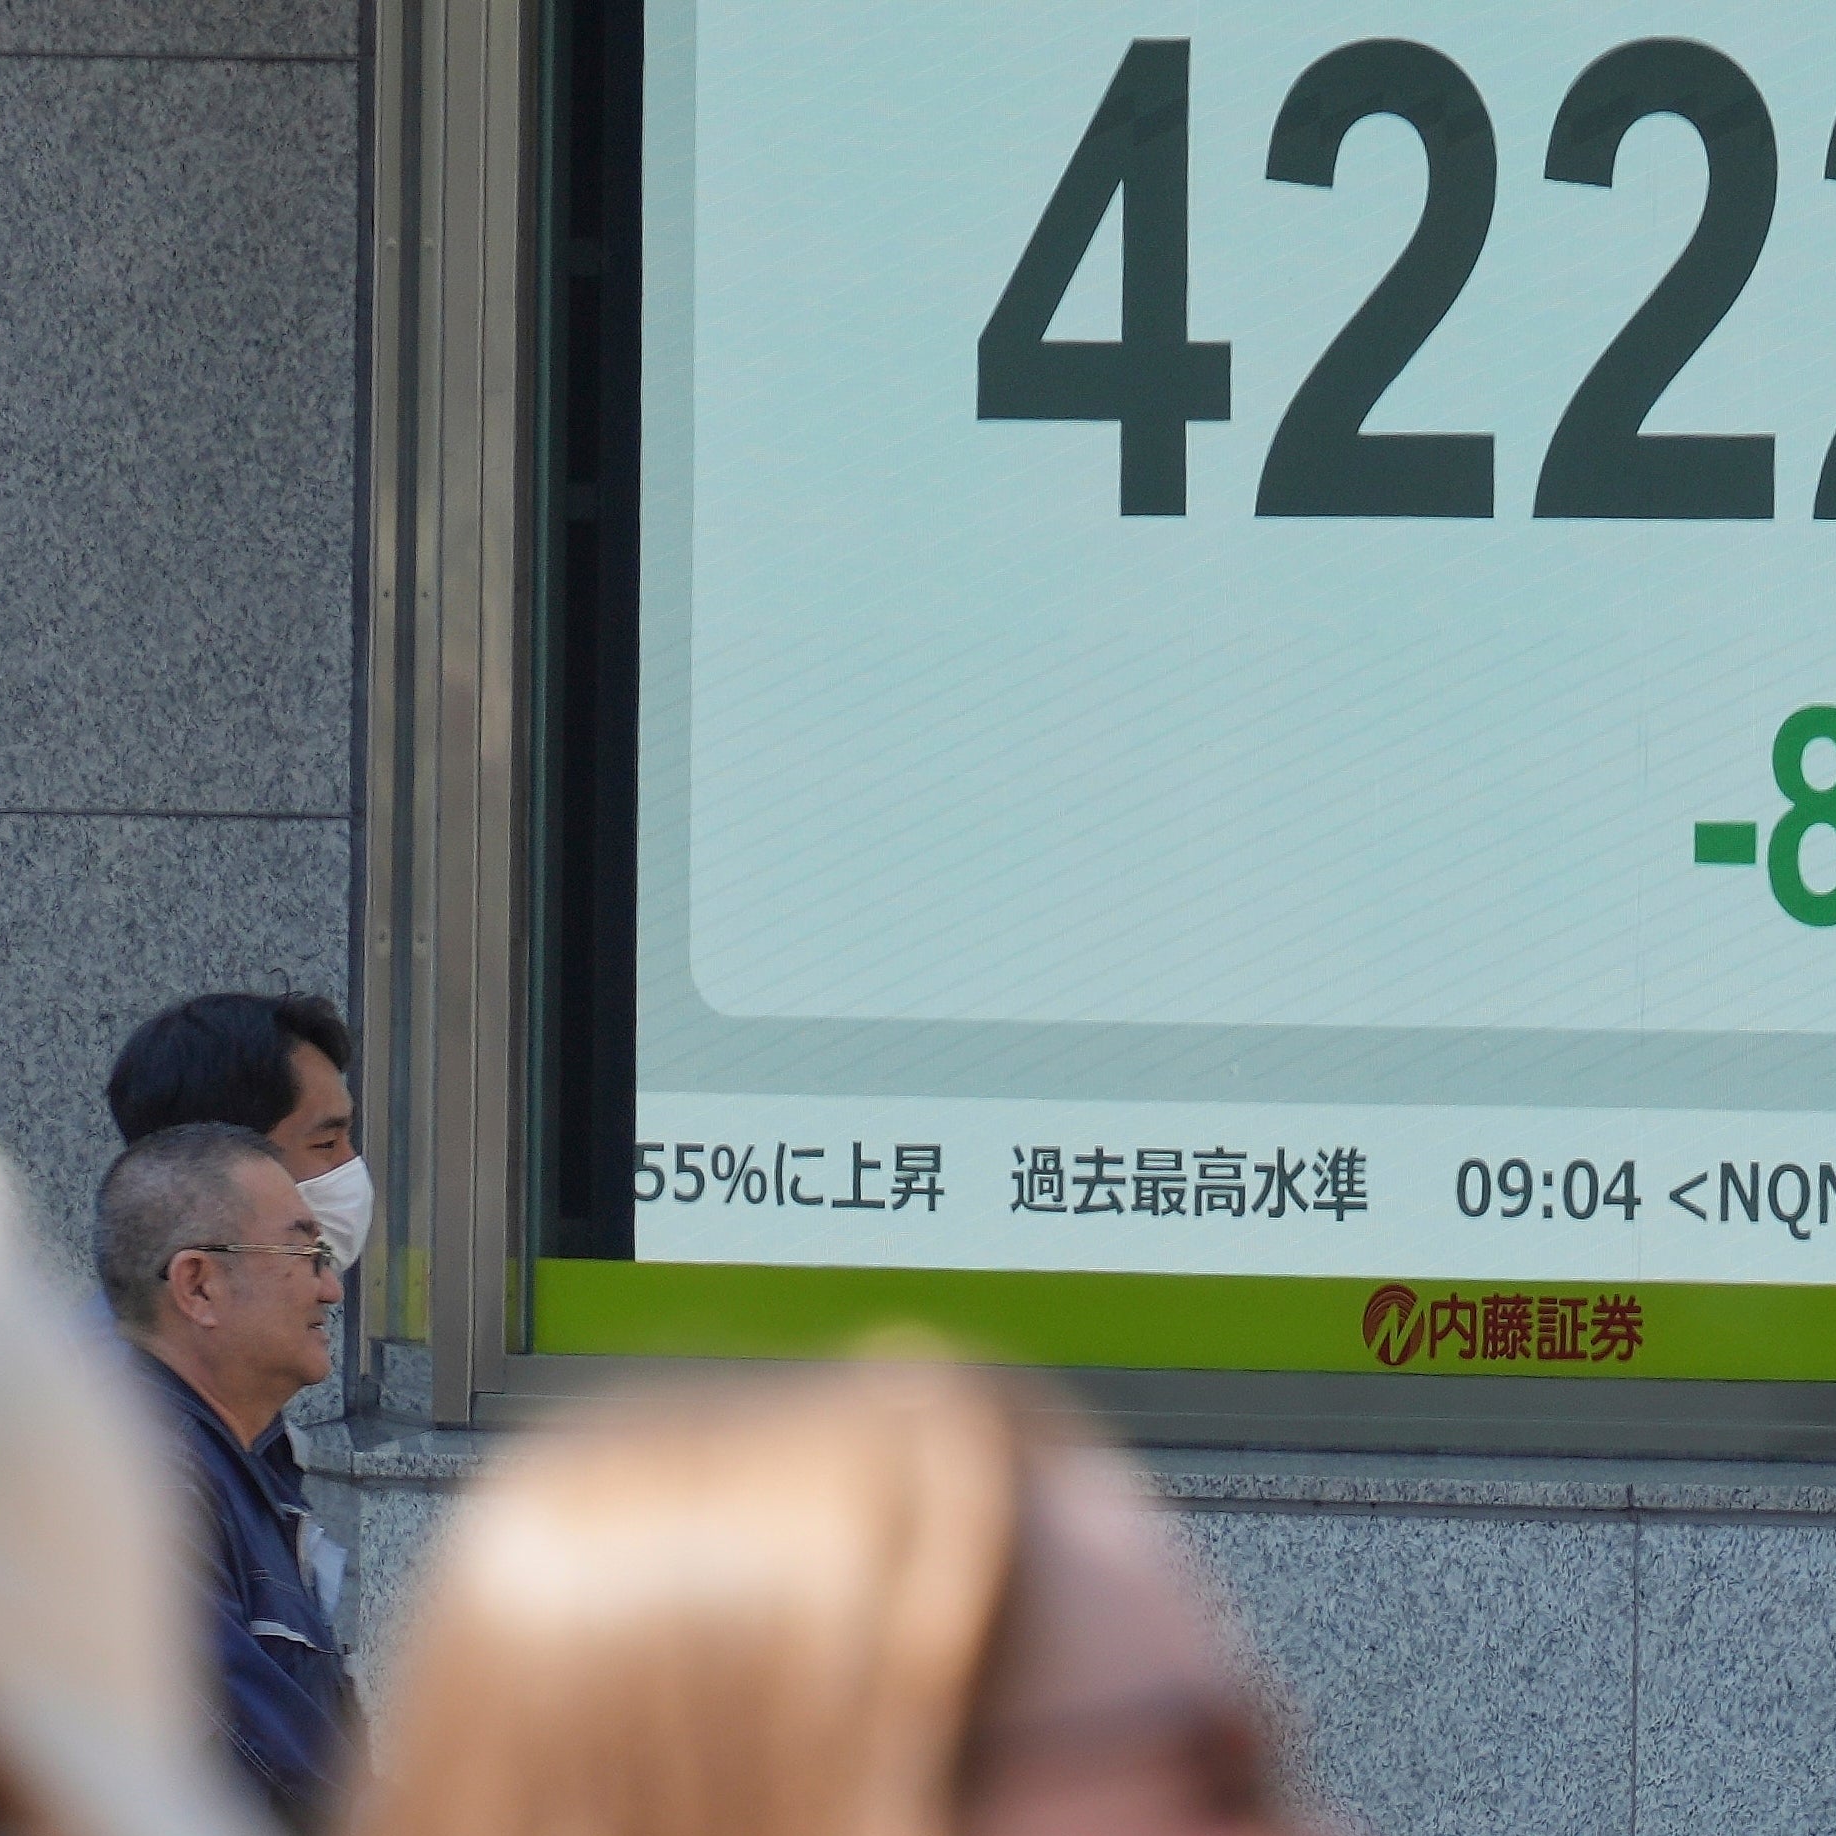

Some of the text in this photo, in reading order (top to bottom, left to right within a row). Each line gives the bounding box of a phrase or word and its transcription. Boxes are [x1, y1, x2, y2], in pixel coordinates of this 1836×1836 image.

[635, 1140, 946, 1213] 55%に上昇
[1009, 1144, 1369, 1223] 過去最高水準
[1454, 1157, 1643, 1222] 09:04
[1429, 1291, 1644, 1361] 内藤証券
